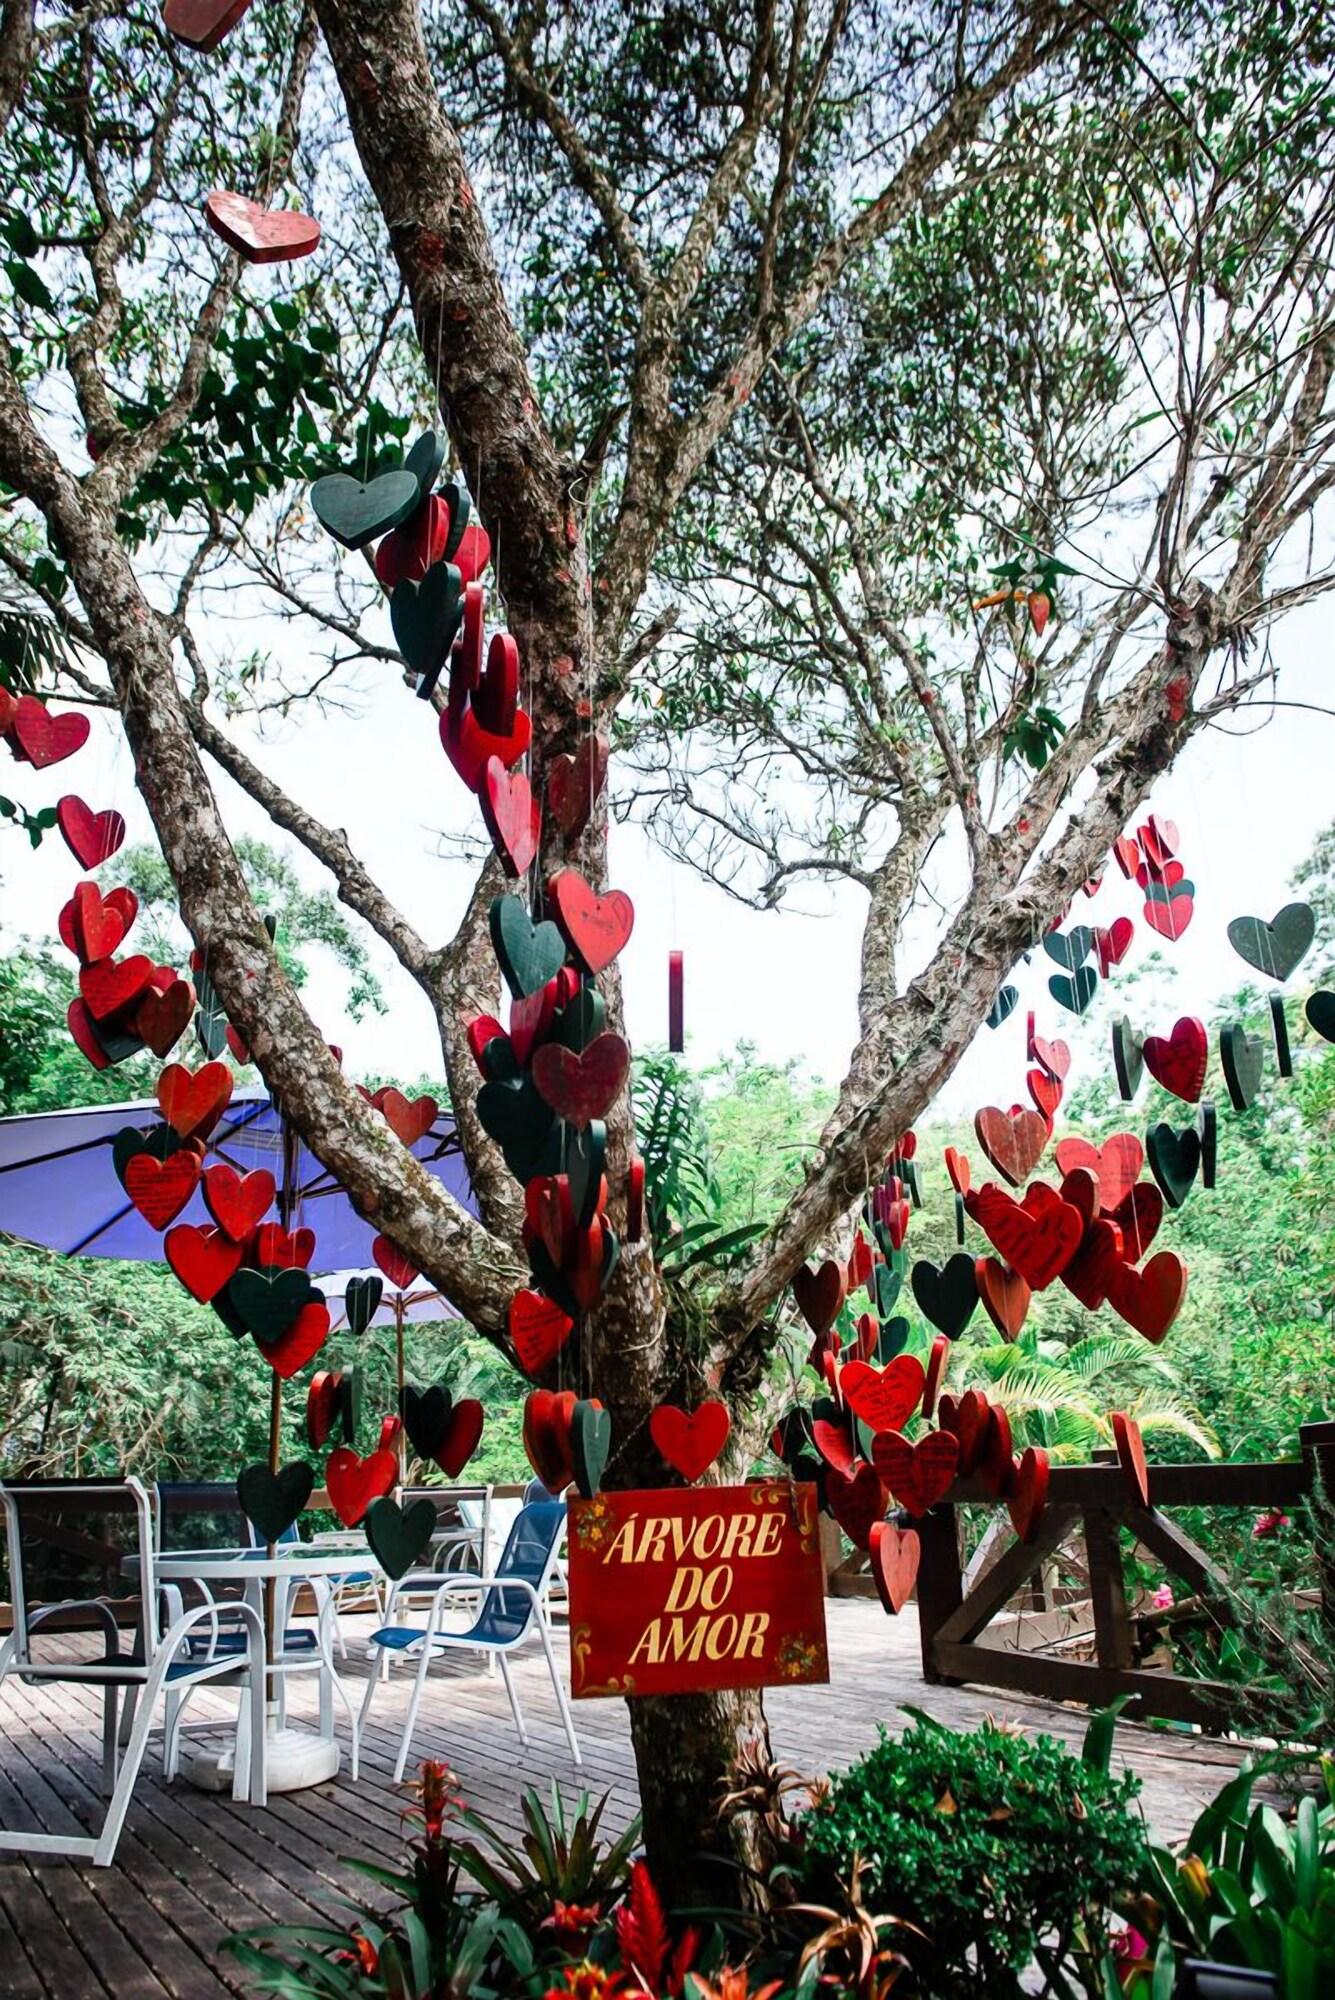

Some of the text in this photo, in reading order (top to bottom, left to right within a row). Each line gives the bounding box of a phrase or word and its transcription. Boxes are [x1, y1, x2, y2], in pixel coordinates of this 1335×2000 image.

[602, 1512, 787, 1565] ÁRVORE
[663, 1564, 734, 1613] DO
[627, 1612, 771, 1665] AMOR
